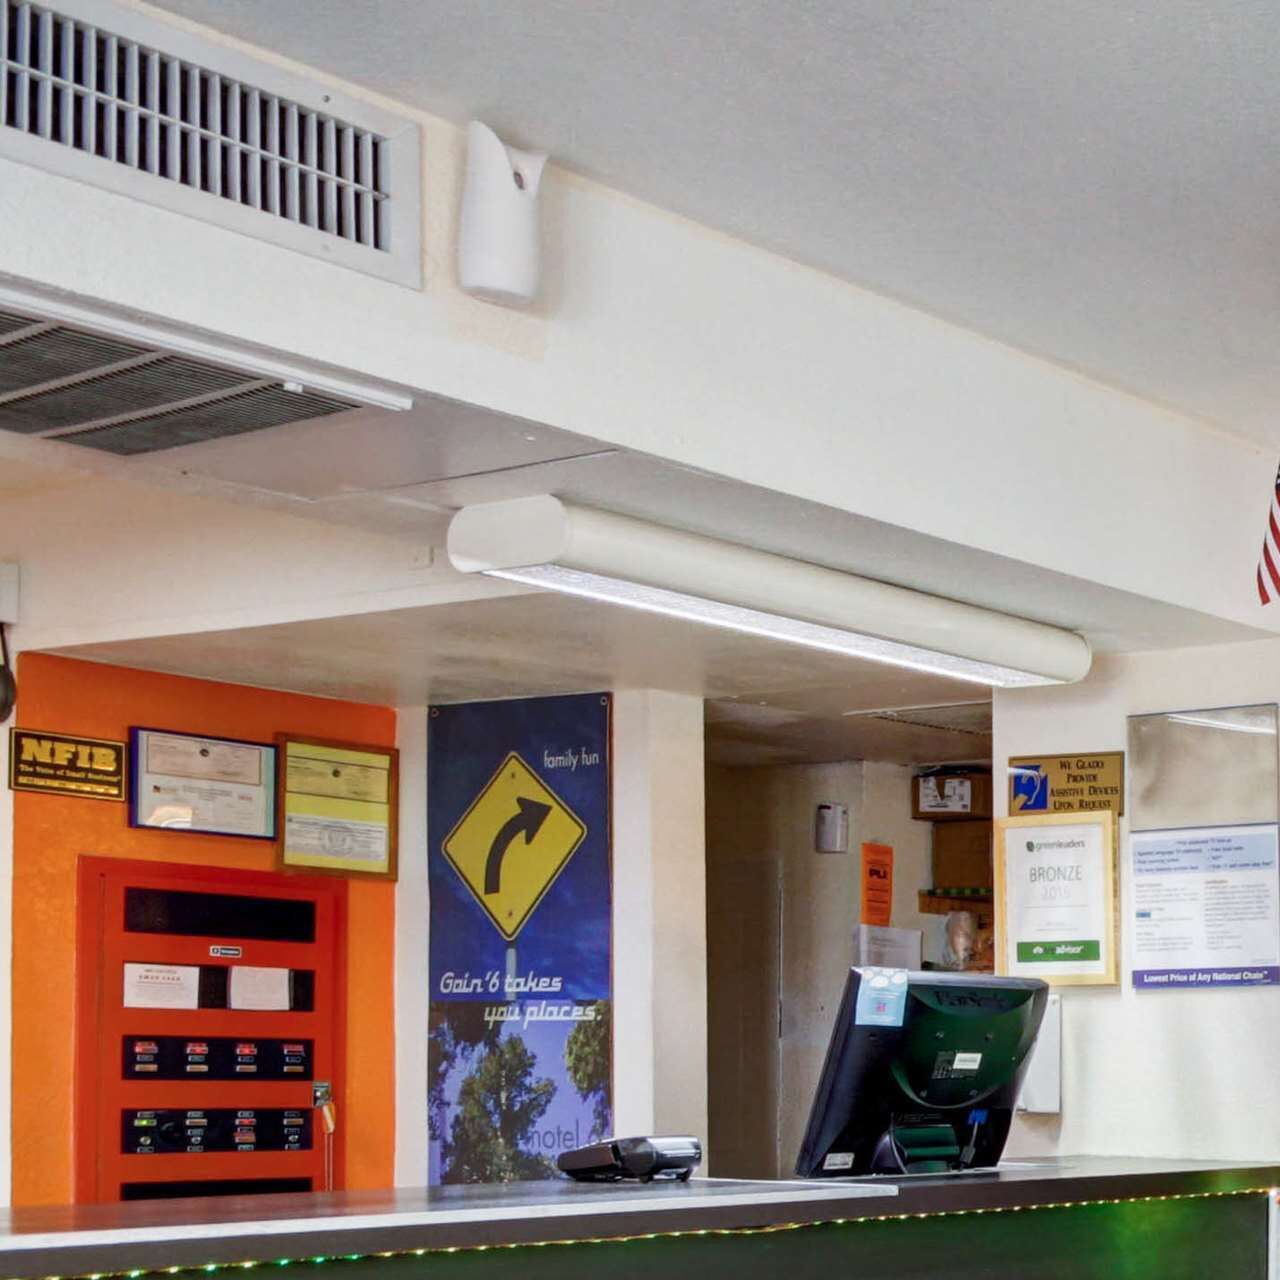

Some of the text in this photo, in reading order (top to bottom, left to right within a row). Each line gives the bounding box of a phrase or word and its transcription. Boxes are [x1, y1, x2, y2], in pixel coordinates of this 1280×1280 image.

[21, 737, 117, 771] NFIB
[544, 746, 599, 771] family fun
[1035, 840, 1085, 852] greenleaders
[1030, 865, 1082, 882] BRONZE
[504, 970, 563, 992] takes
[1144, 974, 1168, 983] Lowest
[1170, 973, 1187, 982] Price
[1198, 973, 1211, 983] Any
[1212, 971, 1241, 981] National
[484, 1001, 602, 1030] you places.
